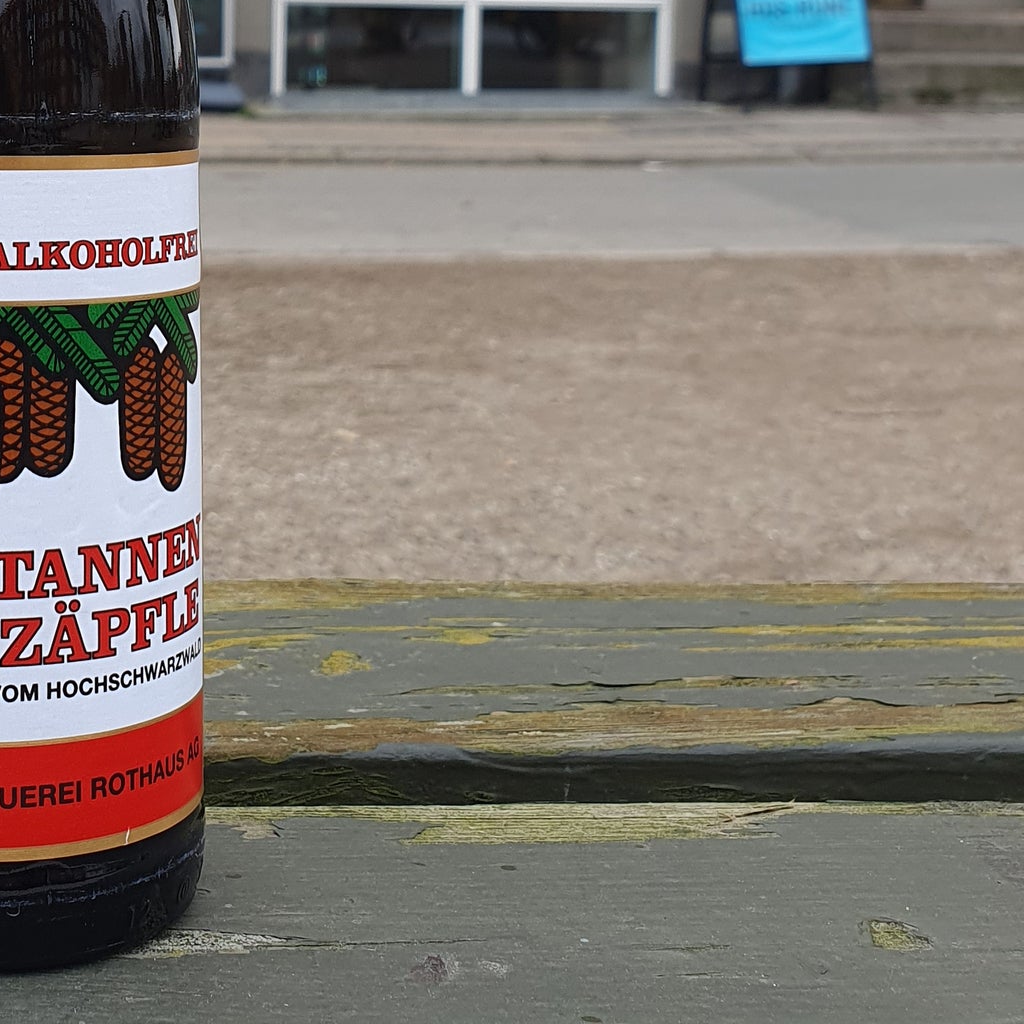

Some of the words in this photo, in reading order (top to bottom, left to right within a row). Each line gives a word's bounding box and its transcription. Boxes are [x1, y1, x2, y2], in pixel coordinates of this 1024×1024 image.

[0, 577, 199, 668] ZÄPFLE
[46, 637, 202, 700] HOCHSCHWARZWALD
[91, 748, 184, 800] ROTHAUS
[187, 735, 200, 766] AG
